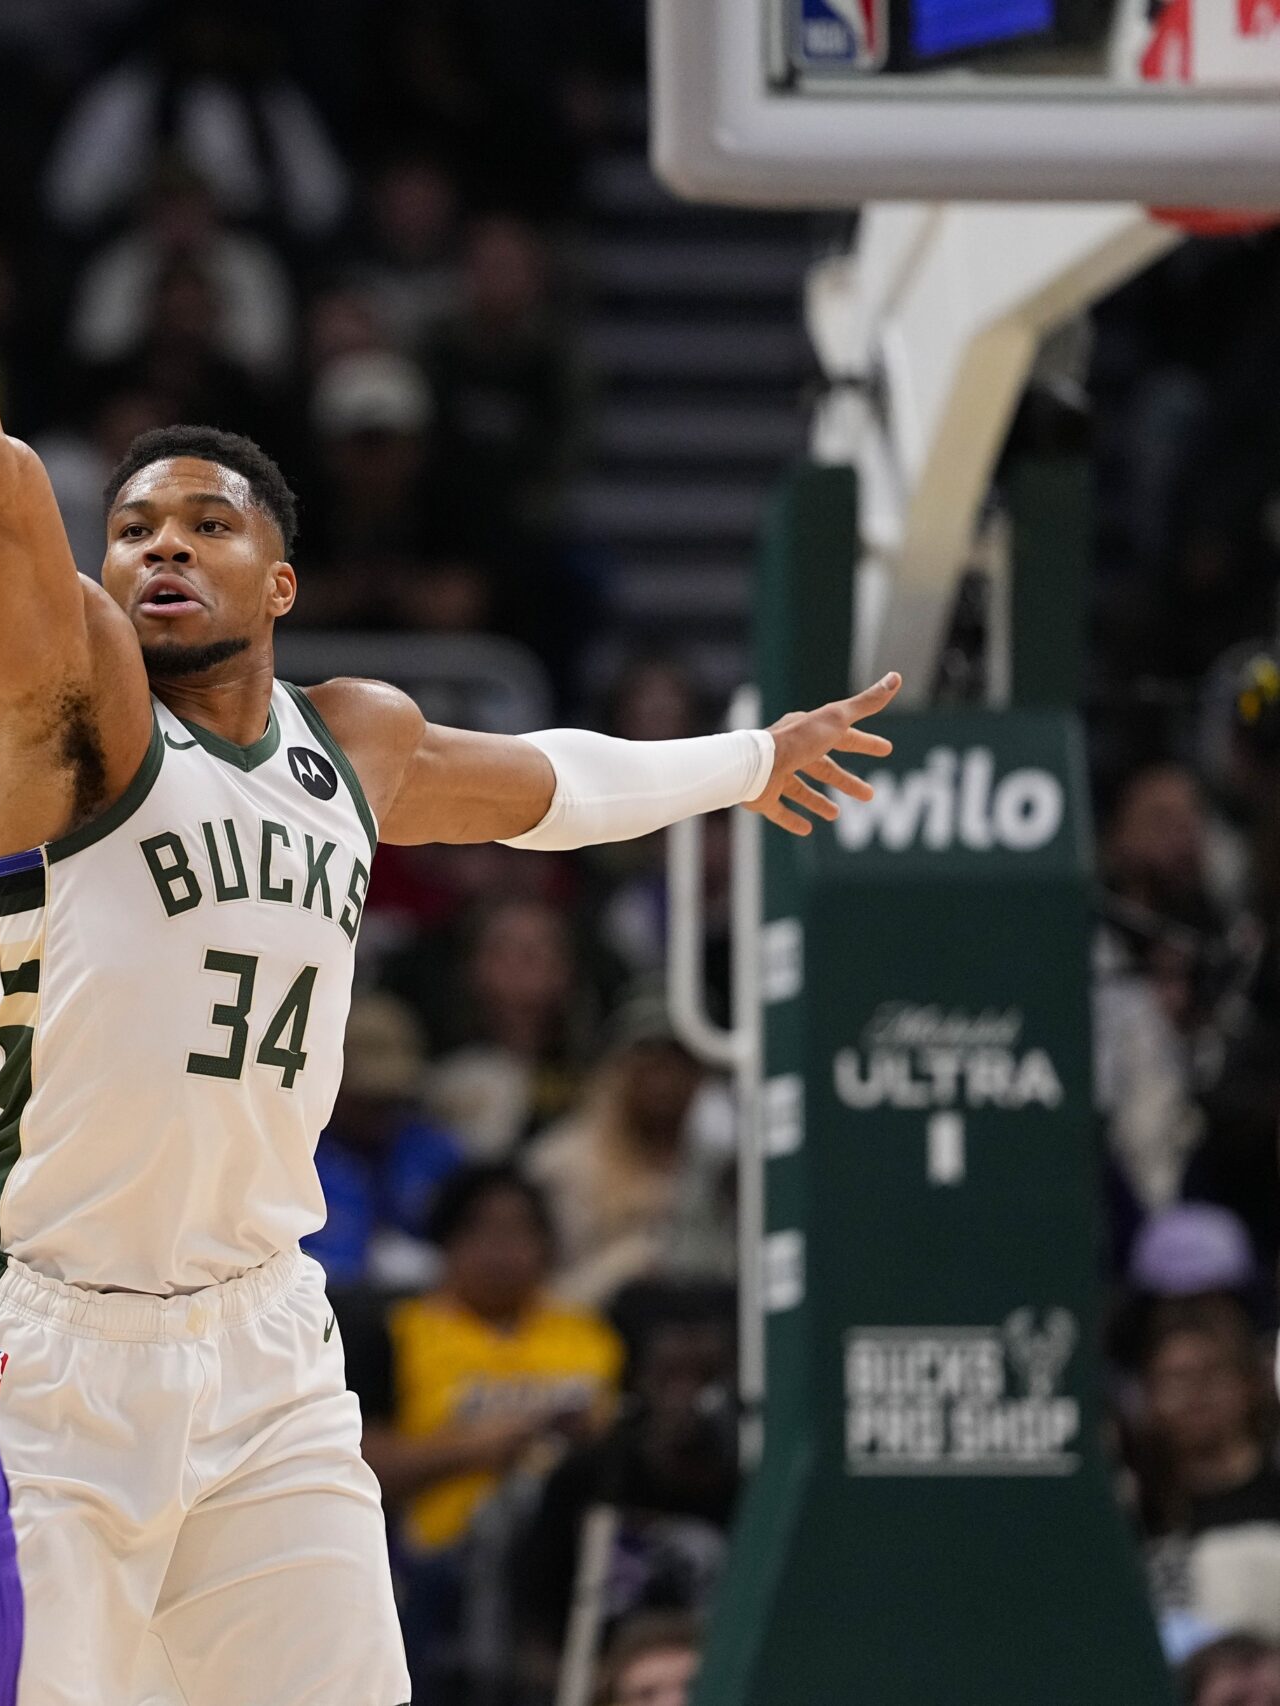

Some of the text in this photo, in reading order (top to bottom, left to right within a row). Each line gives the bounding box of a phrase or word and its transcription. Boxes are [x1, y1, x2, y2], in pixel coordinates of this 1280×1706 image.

[830, 746, 1064, 852] wilo
[136, 816, 371, 946] BUCKS
[184, 944, 320, 1093] 34
[834, 1048, 1066, 1110] ULTRA
[846, 1339, 1005, 1397] BUCKS
